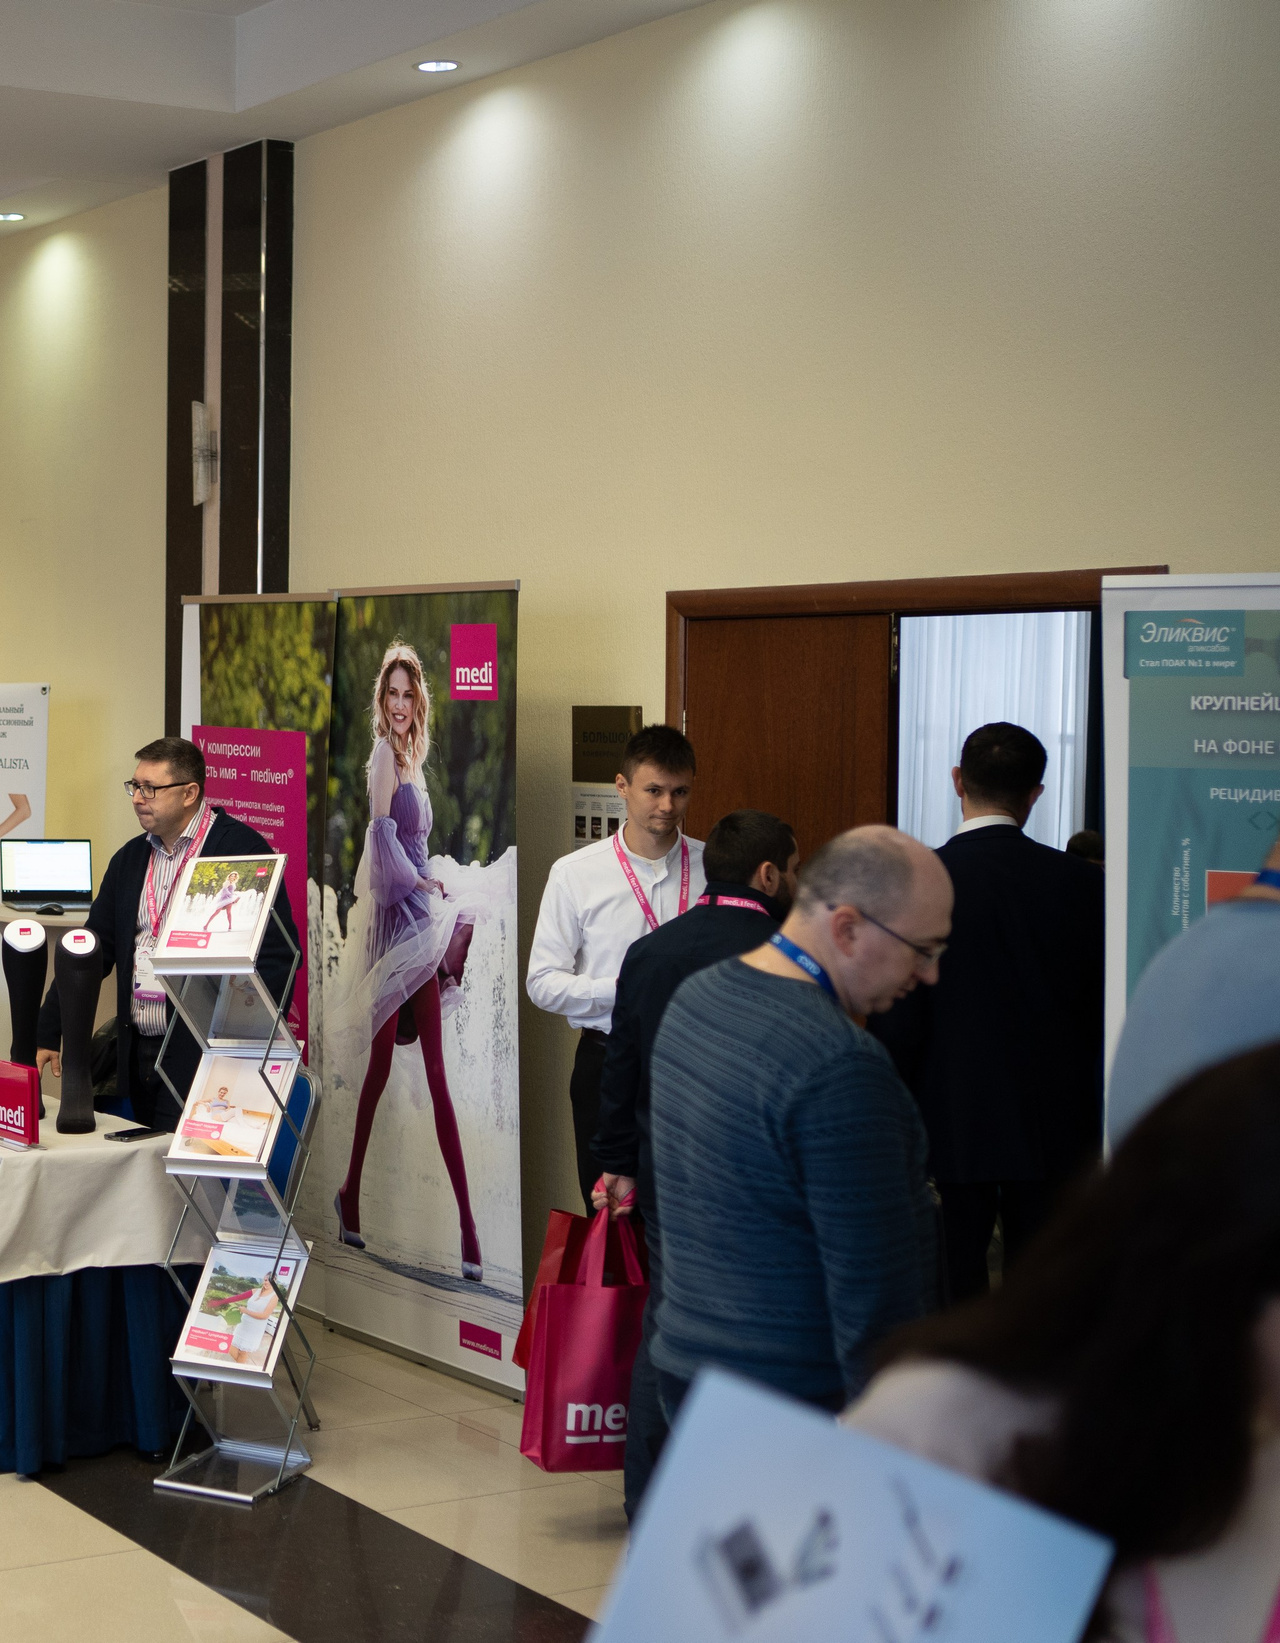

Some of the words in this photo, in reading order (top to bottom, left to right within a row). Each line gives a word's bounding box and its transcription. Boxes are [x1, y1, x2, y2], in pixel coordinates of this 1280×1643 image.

[1140, 659, 1160, 667] Стал
[1161, 659, 1186, 667] ПОАК
[1188, 659, 1203, 667] №1
[456, 661, 492, 684] medi
[207, 742, 261, 759] компрессии
[1194, 739, 1219, 754] НА
[1222, 739, 1275, 755] ФОНЕ
[205, 765, 218, 778] сть
[204, 797, 233, 807] едицинский
[235, 799, 262, 810] трикотаж
[262, 802, 285, 813] mediven
[1172, 867, 1181, 916] Количество
[1182, 899, 1190, 932] иентов
[566, 1403, 629, 1431] me
